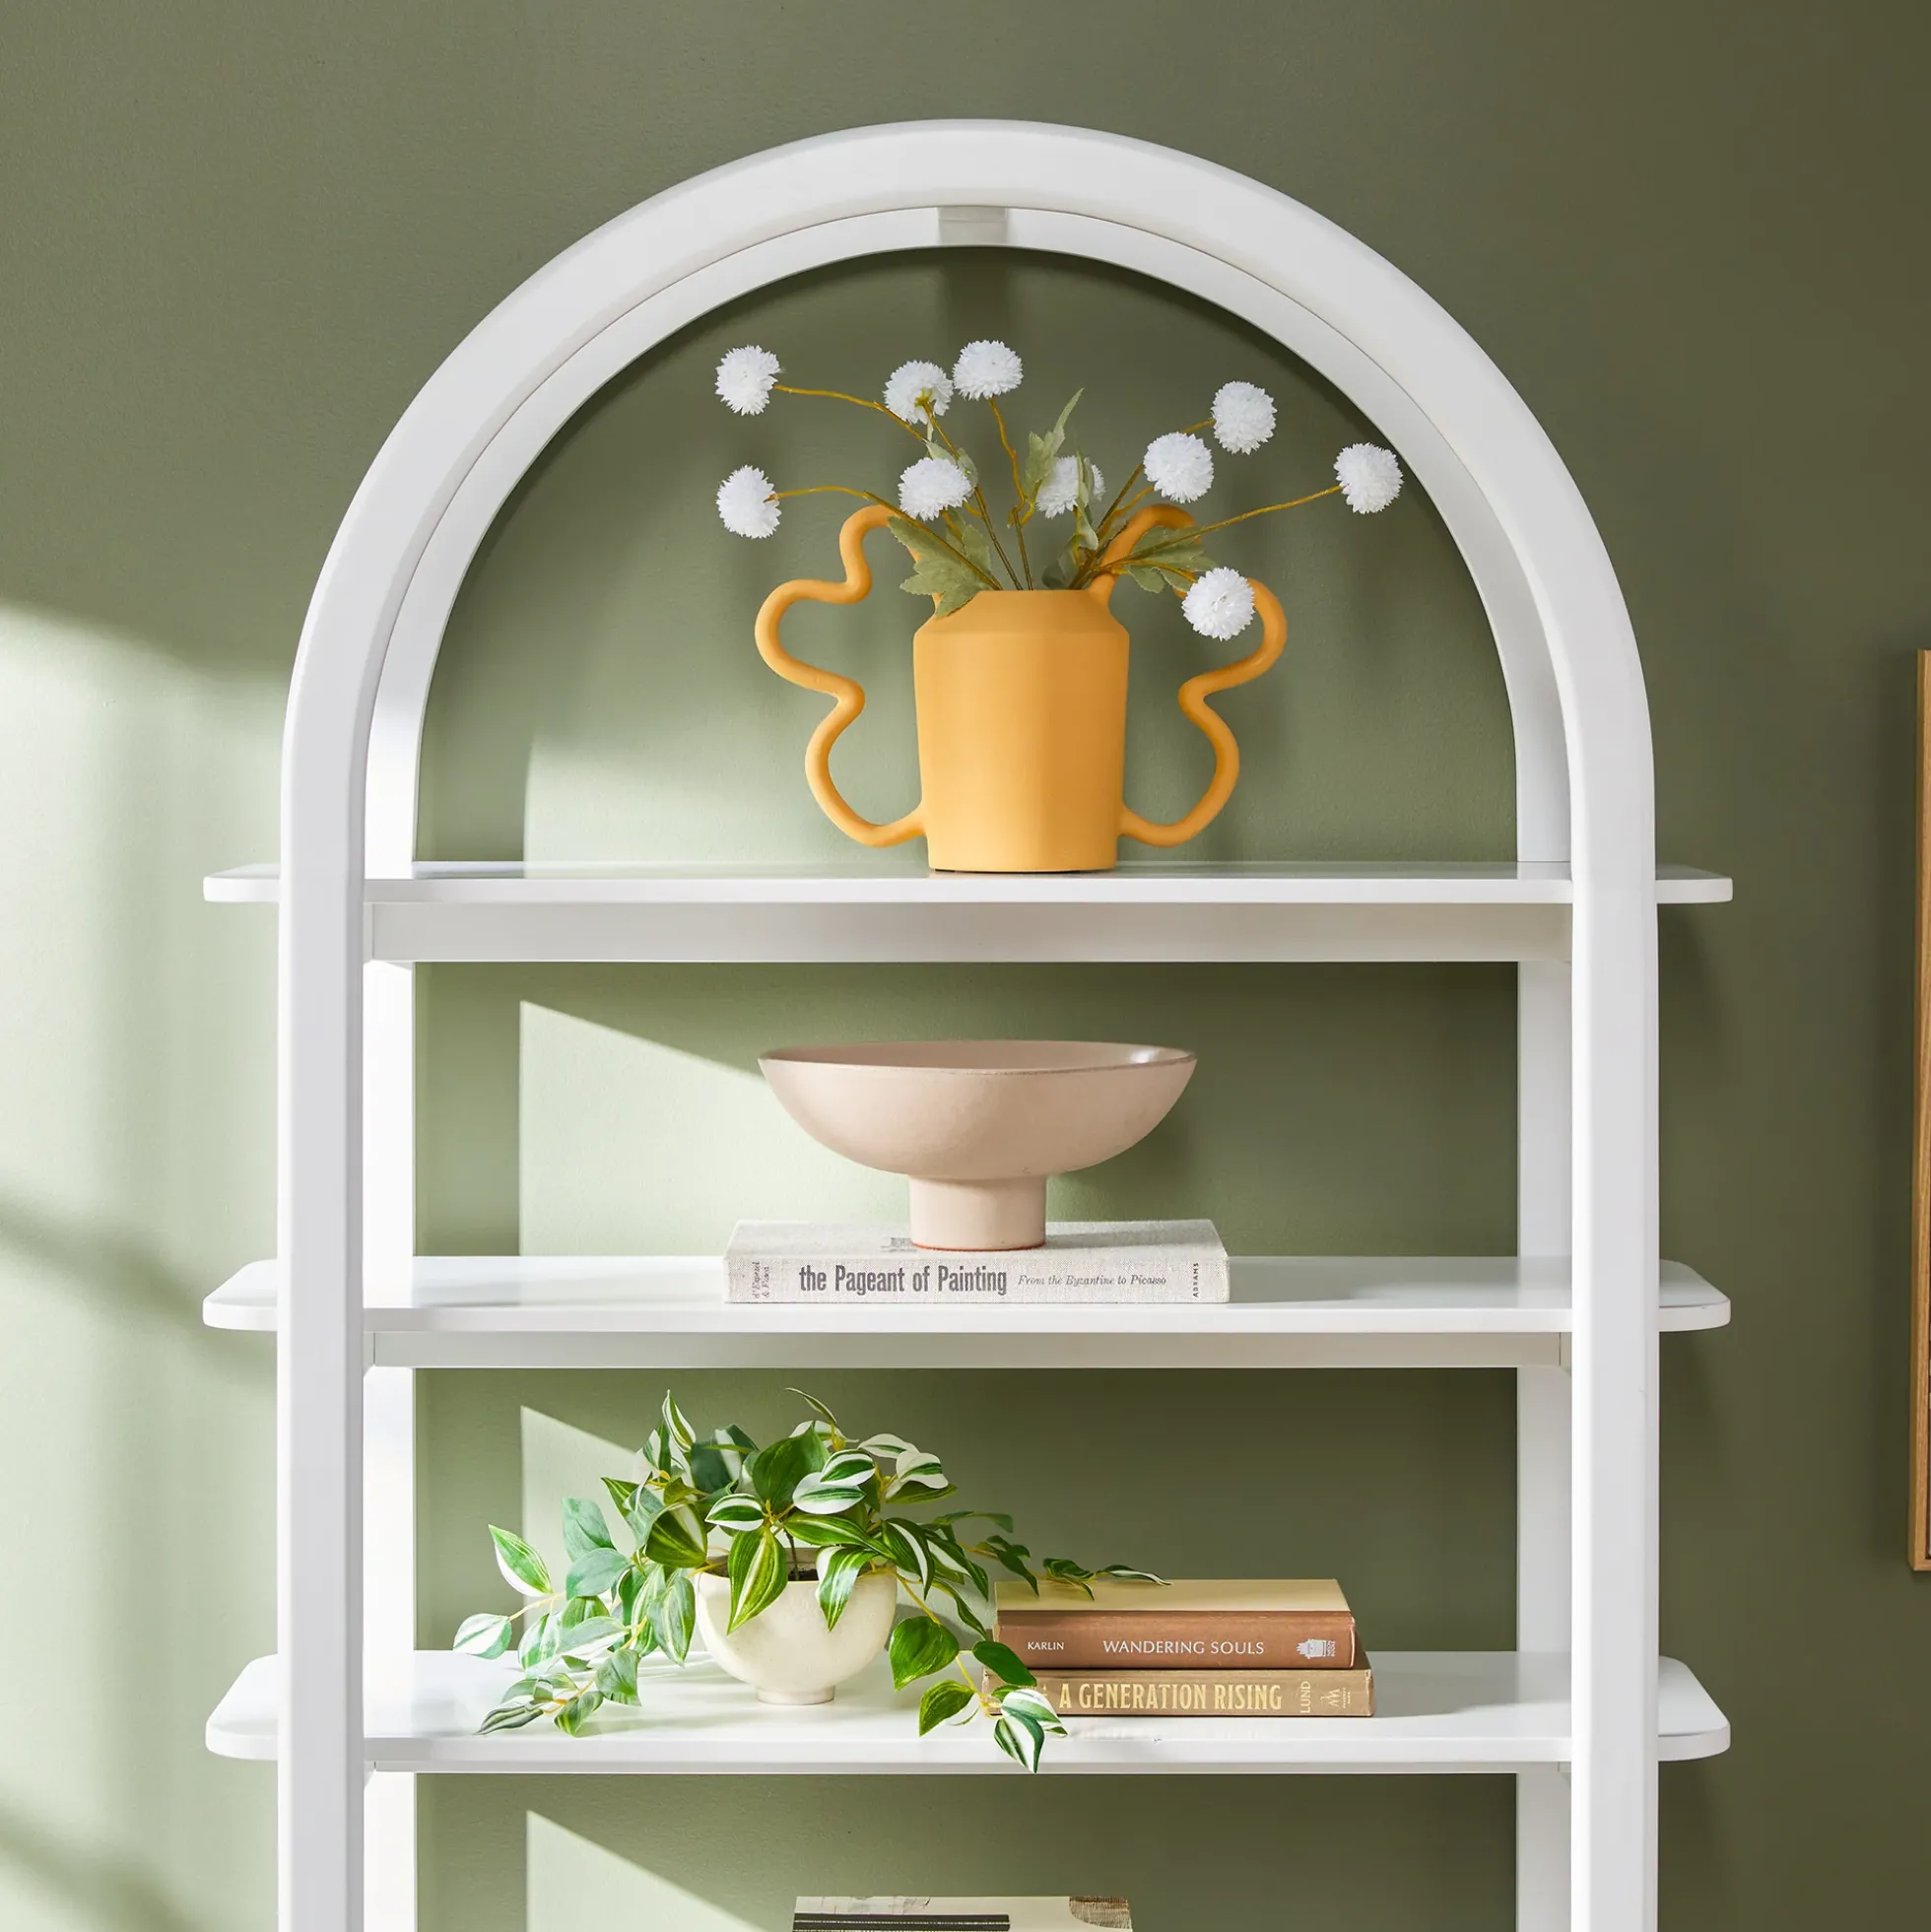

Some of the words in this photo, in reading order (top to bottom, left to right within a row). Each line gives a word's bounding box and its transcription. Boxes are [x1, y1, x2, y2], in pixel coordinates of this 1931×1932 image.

[799, 1265, 827, 1291] the
[835, 1265, 904, 1297] Pageant
[912, 1265, 930, 1292] of
[939, 1265, 1007, 1297] Painting
[1018, 1274, 1044, 1285] From
[1048, 1274, 1061, 1285] the
[1066, 1274, 1113, 1287] Byzantine
[1117, 1275, 1126, 1285] to
[1131, 1275, 1166, 1285] Picasso
[1103, 1640, 1205, 1654] WANDERING
[1210, 1641, 1265, 1654] SOULS
[1059, 1684, 1072, 1708] A
[1079, 1683, 1207, 1709] GENERATION
[1214, 1684, 1282, 1710] RISING
[1300, 1681, 1311, 1713] LUND
